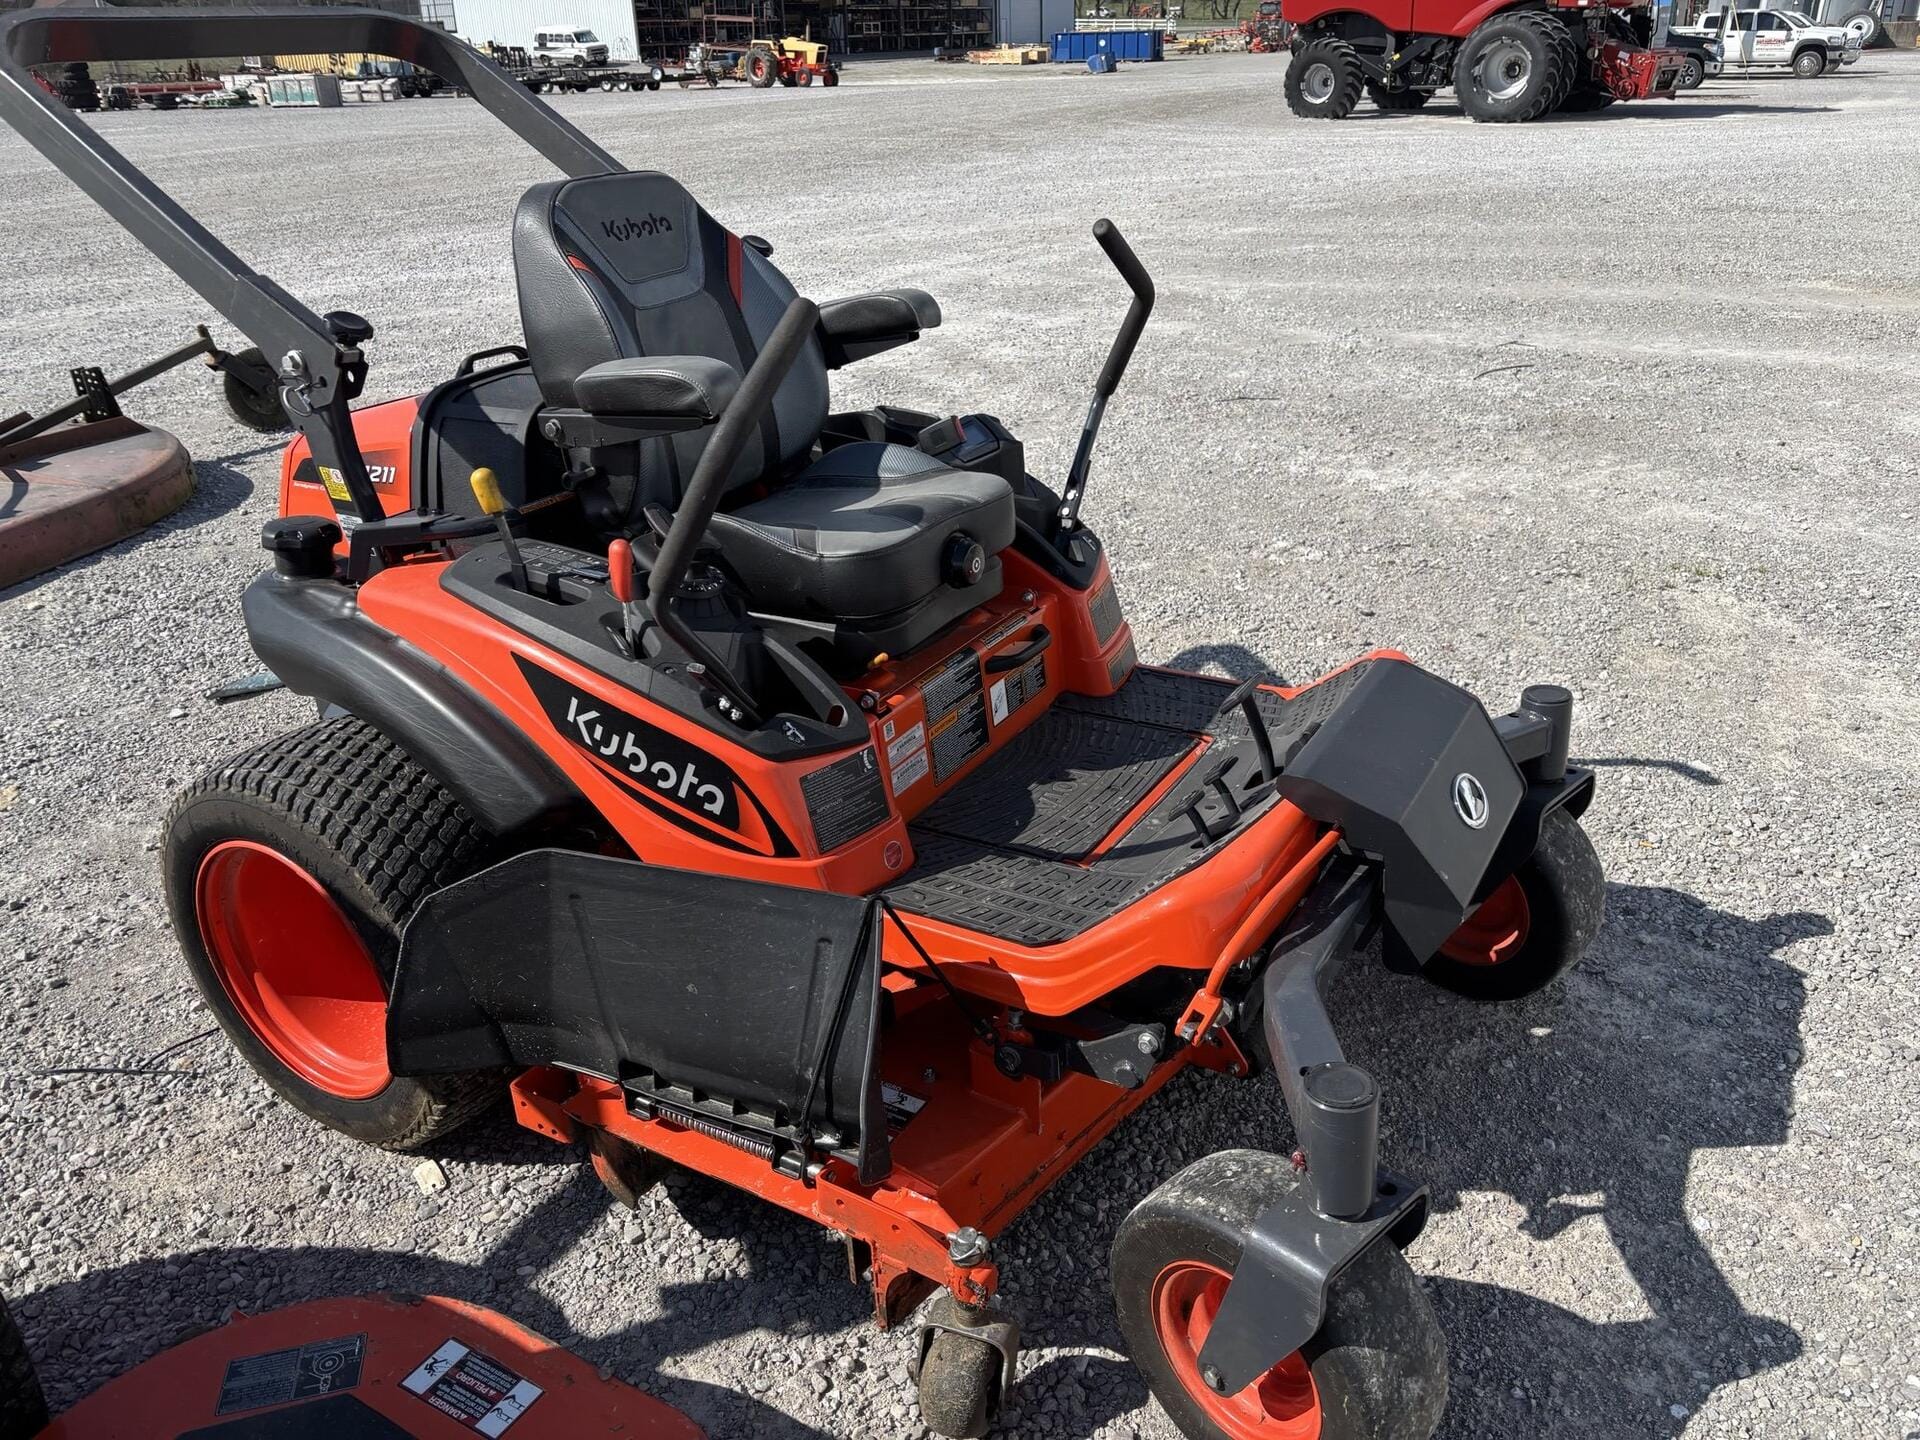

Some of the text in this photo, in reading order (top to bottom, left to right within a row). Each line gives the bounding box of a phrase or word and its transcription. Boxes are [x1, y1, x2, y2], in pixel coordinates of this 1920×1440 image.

[601, 213, 672, 241] Kubota
[567, 696, 725, 816] Kubota
[455, 1371, 488, 1394] PELIGRO
[427, 1395, 463, 1418] DANGER
